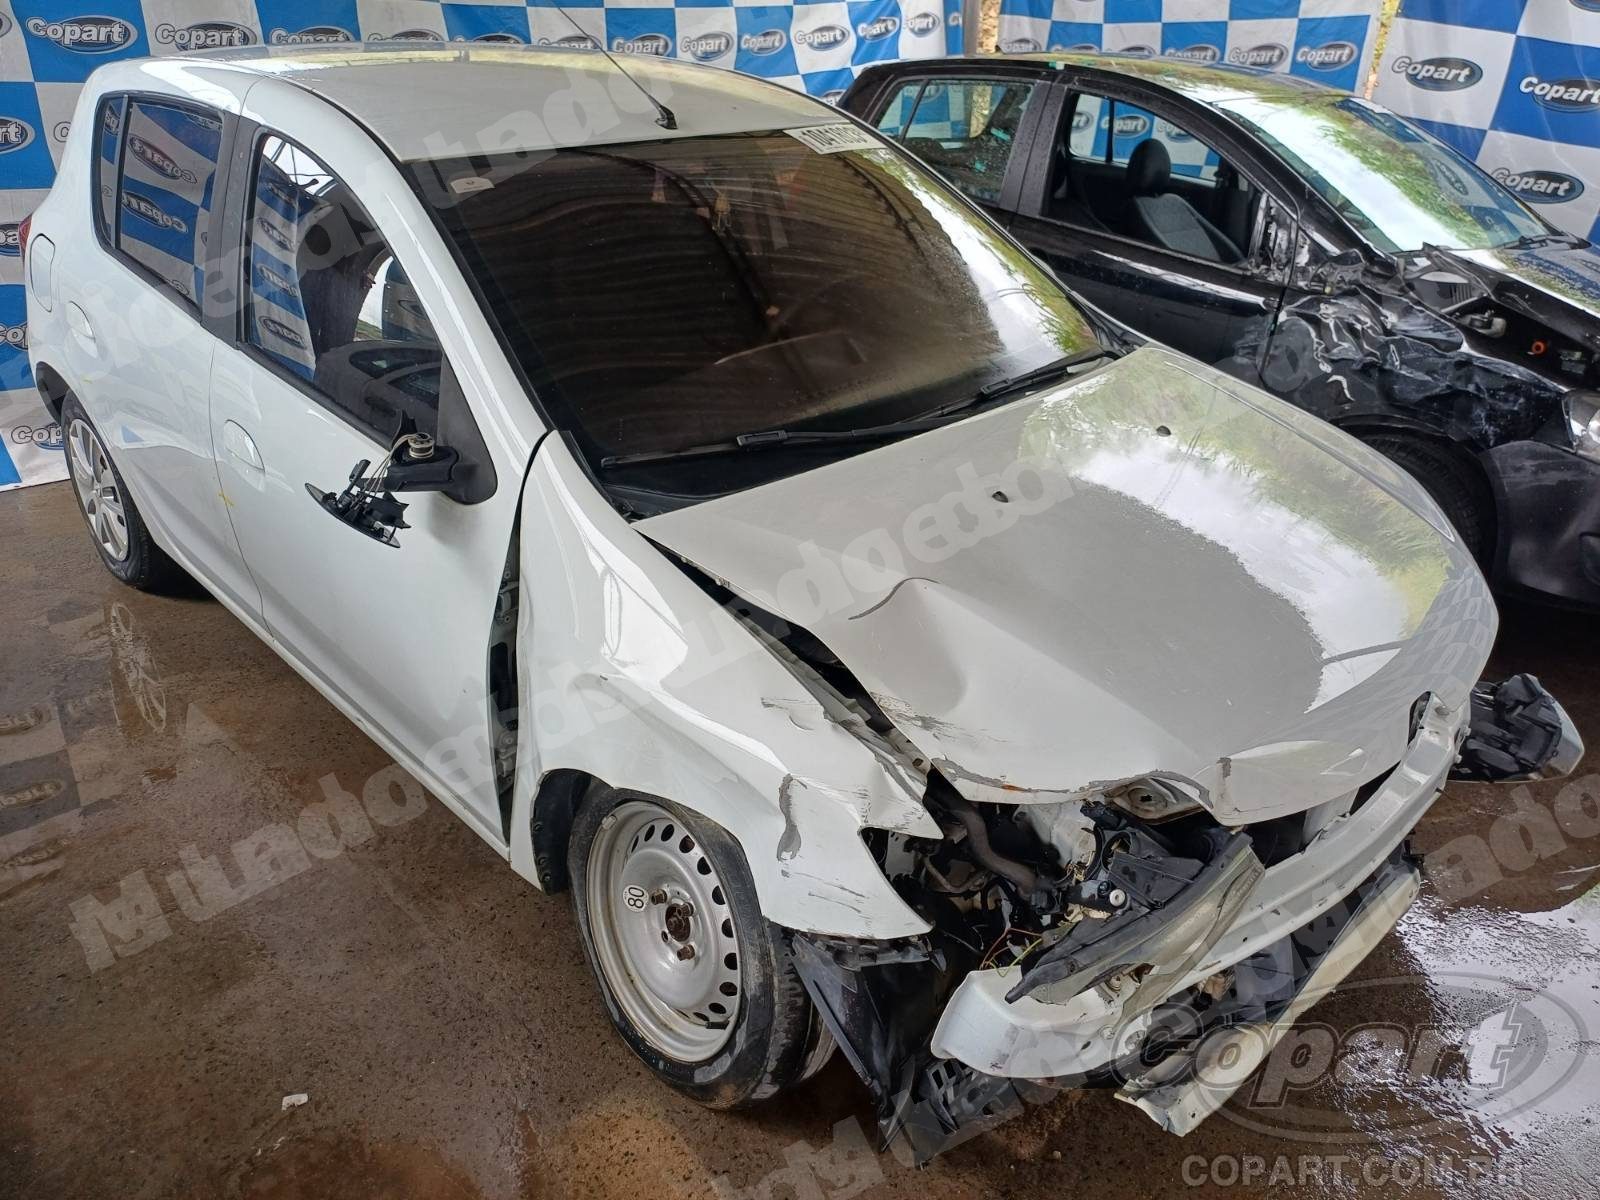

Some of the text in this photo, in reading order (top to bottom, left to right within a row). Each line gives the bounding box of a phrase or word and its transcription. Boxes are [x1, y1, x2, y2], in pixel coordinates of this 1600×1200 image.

[26, 18, 125, 44] Copart
[154, 23, 246, 50] Copart
[794, 30, 843, 47] Copart
[612, 36, 666, 54] Copart
[680, 36, 727, 57] Copart
[741, 33, 782, 52] Copart
[1229, 46, 1281, 66] Copart
[1296, 46, 1350, 67] Copart
[1392, 56, 1471, 83] Copart
[1519, 76, 1600, 105] Copart
[1101, 116, 1143, 134] Cpart
[1490, 167, 1572, 196] Copart
[11, 426, 64, 445] Cop
[628, 886, 645, 909] 80
